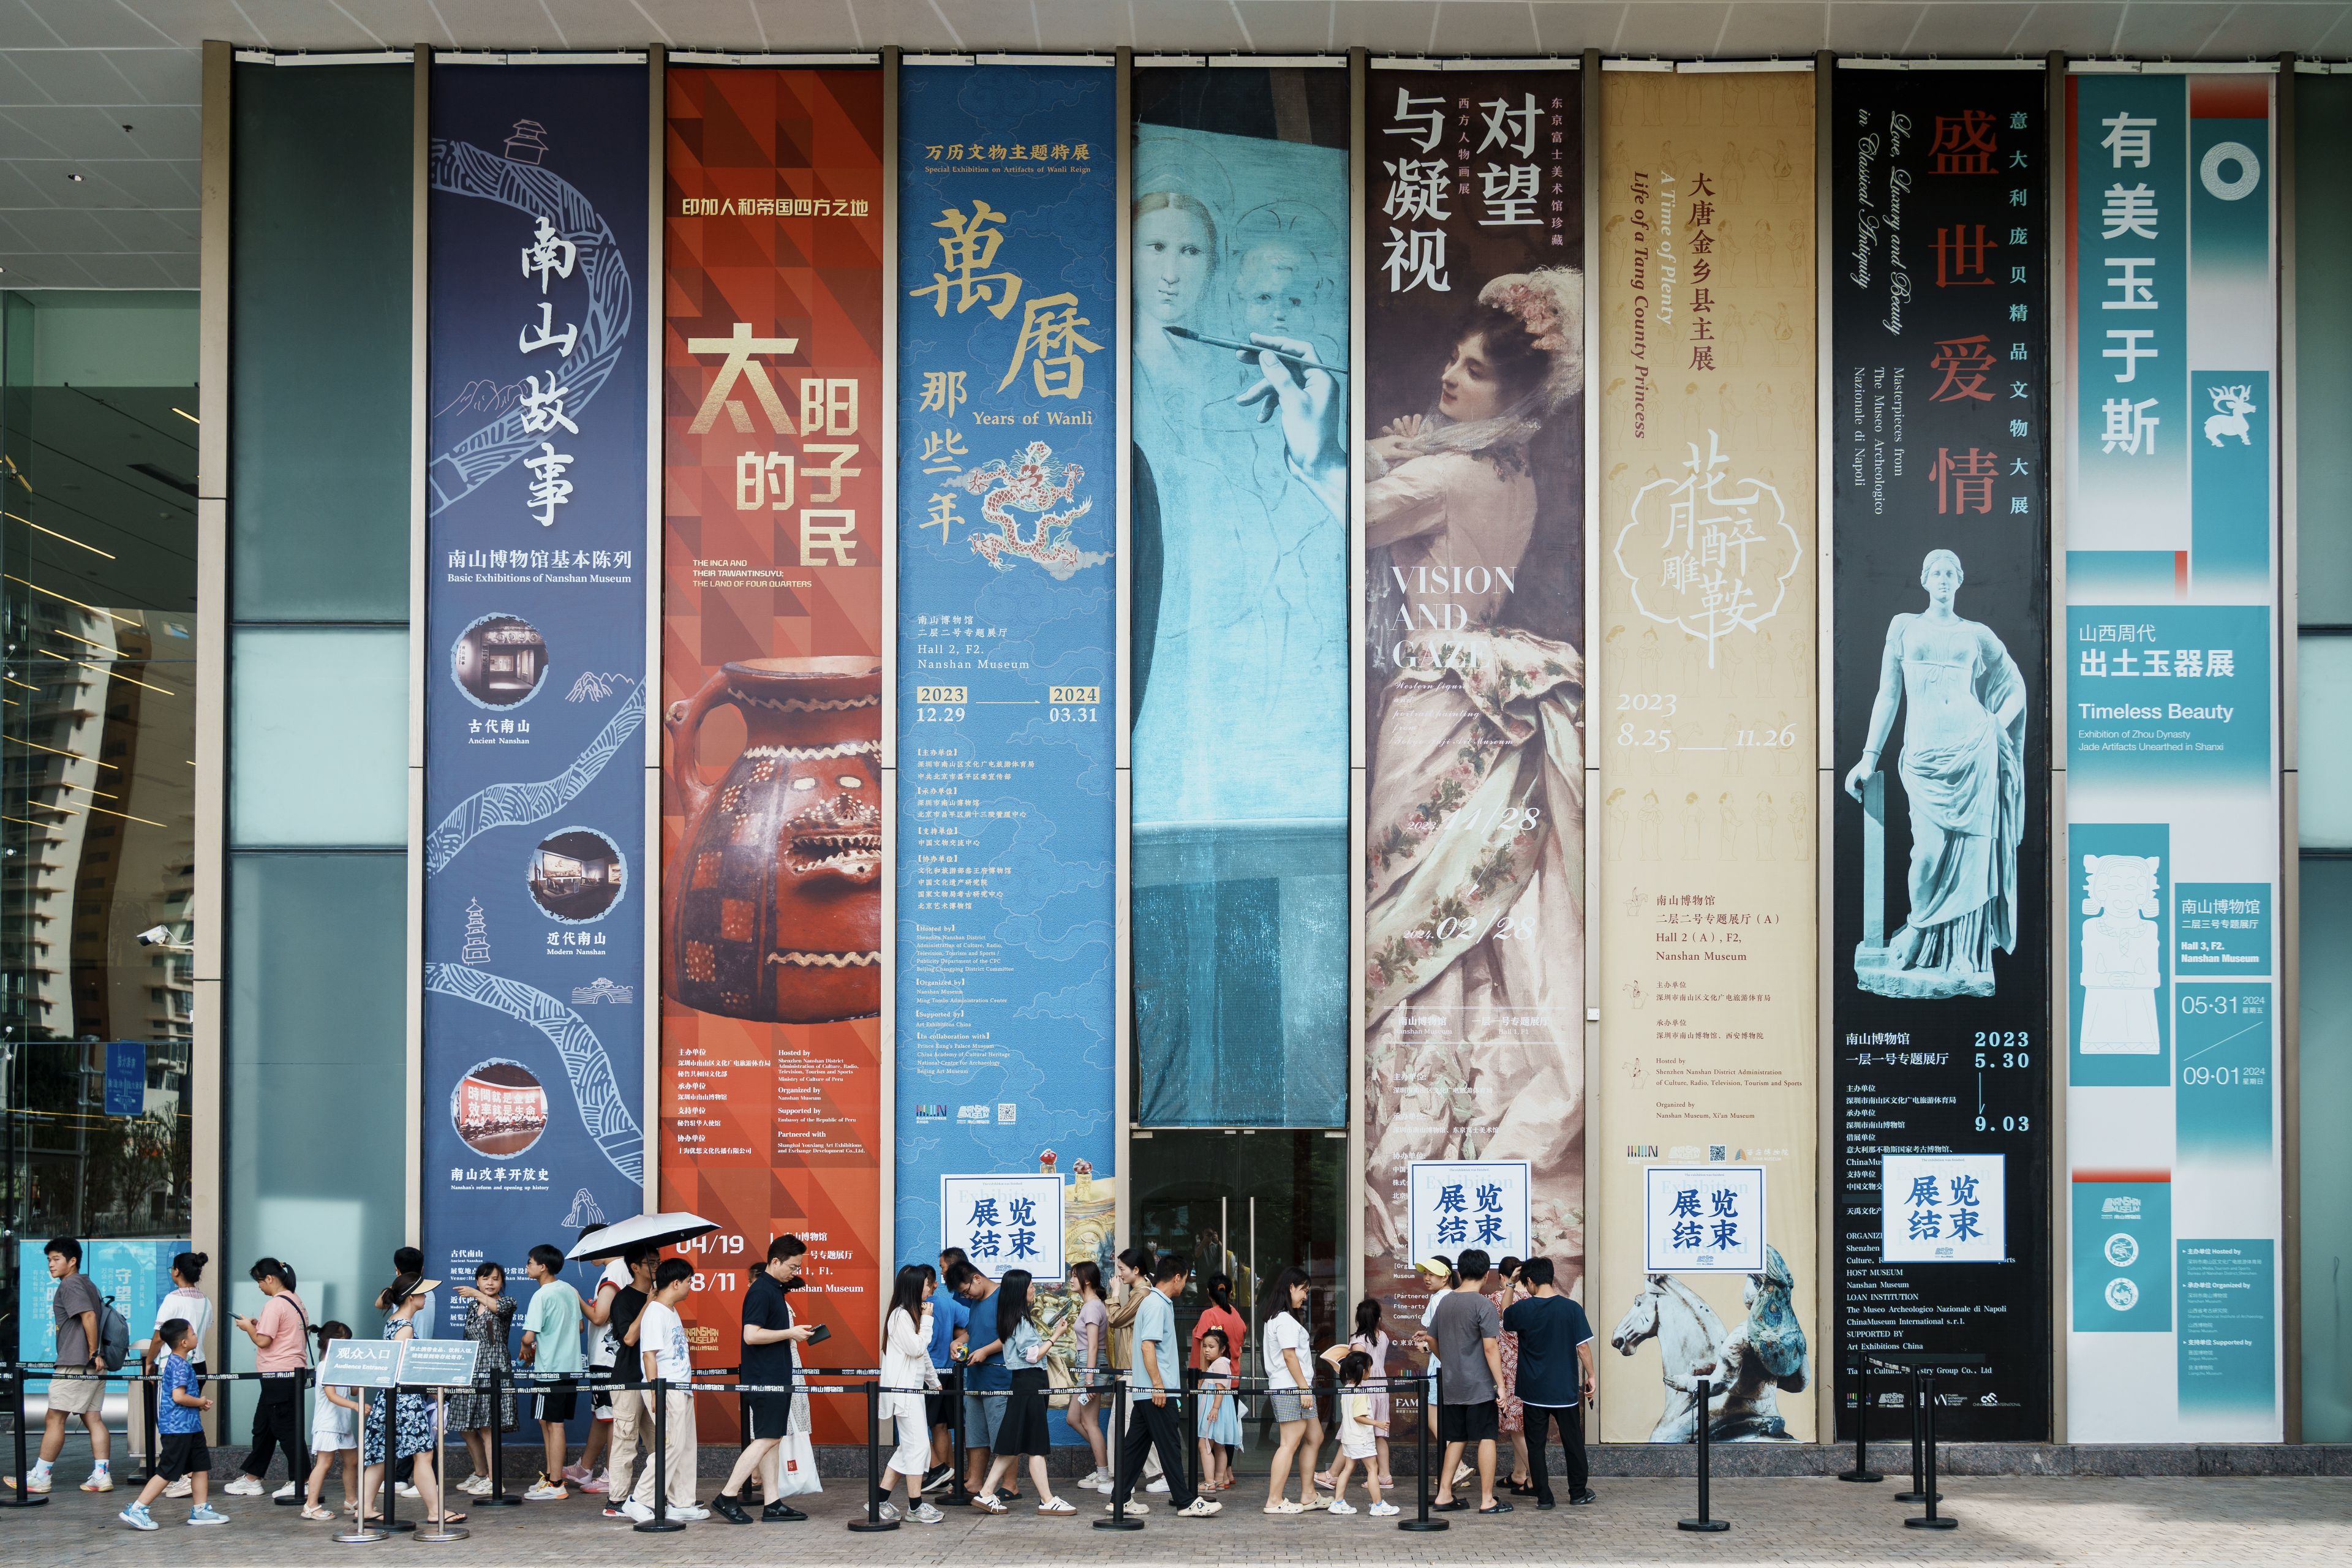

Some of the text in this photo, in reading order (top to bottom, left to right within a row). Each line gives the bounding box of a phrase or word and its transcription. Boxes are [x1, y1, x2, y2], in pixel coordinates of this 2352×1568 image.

[925, 144, 1091, 161] 万历文物主题特展
[1458, 97, 1470, 195] 西方人物画展
[1476, 92, 1545, 226] 对望
[1070, 166, 1091, 175] Reign
[1551, 97, 1564, 246] 东京富士美术馆珍藏
[1381, 87, 1452, 293] 与凝视
[1850, 108, 1879, 289] in Classical Antiquity
[682, 198, 869, 217] 印加人和帝国四方之地
[1882, 111, 1911, 337] Love, Luxury and Beauty
[1657, 170, 1676, 325] A Time of Plenty
[1687, 172, 1716, 372] 大唐金乡县主展
[2101, 111, 2160, 456] 有美玉于斯
[1630, 171, 1649, 439] Life of a Tang County Princess
[1928, 110, 1999, 514] 盛世爱情
[2009, 111, 2029, 514] 意大利庞贝精品文物大展
[519, 216, 579, 527] 南山故事
[973, 411, 1093, 425] Years of Wanli
[1852, 368, 1865, 486] Nazionale di Napoli
[1891, 368, 1904, 477] Masterpieces from
[1872, 368, 1885, 514] The Museo Archeologico
[919, 371, 968, 545] 那些年
[448, 549, 632, 569] 南山博物馆基本陈列
[448, 574, 631, 582] Basic Exhibitions of Nanshan Museum
[1390, 566, 1518, 595] VISION
[918, 615, 974, 625] 南山博物馆
[1390, 603, 1468, 631] AND
[918, 628, 1008, 638] 二层二号专题展厅
[2079, 624, 2156, 643] 山西周代
[1393, 640, 1490, 669] GAZE
[2080, 648, 2235, 677] 出土玉器展
[921, 688, 964, 701] 2023
[1054, 688, 1097, 701] 2024
[917, 707, 965, 722] 12.29
[1049, 707, 1098, 722] 03.31
[1616, 693, 1677, 717] 2023
[2078, 704, 2234, 723] Timeless Beauty
[468, 719, 530, 733] 古代南山
[2157, 730, 2190, 740] Dynasty
[1617, 722, 1796, 753] 8.25 11.26
[1656, 894, 1716, 907] 南山博物馆
[2181, 899, 2260, 914] 南山博物馆
[2182, 919, 2259, 929] 二层三号专题展厅
[547, 932, 606, 946] 近代南山
[2181, 954, 2259, 963] Nanshan Museum
[1656, 993, 1771, 1002] 深圳市南山区文化广电旅游体育局
[1845, 1032, 1910, 1045] 南山博物馆
[1975, 1031, 2029, 1047] 2023
[1845, 1052, 1949, 1066] 一层一号专题展厅
[1975, 1053, 2029, 1068] 5.30
[1975, 1116, 2029, 1131] 9.03
[451, 1167, 549, 1182] 南山改革开放史
[1904, 1174, 1980, 1208] 展览
[1668, 1188, 1738, 1218] 展览
[1907, 1208, 1984, 1242] 结束
[676, 1235, 744, 1254] 04/19
[1672, 1219, 1742, 1251] 结束
[336, 1347, 390, 1360] 观众入口
